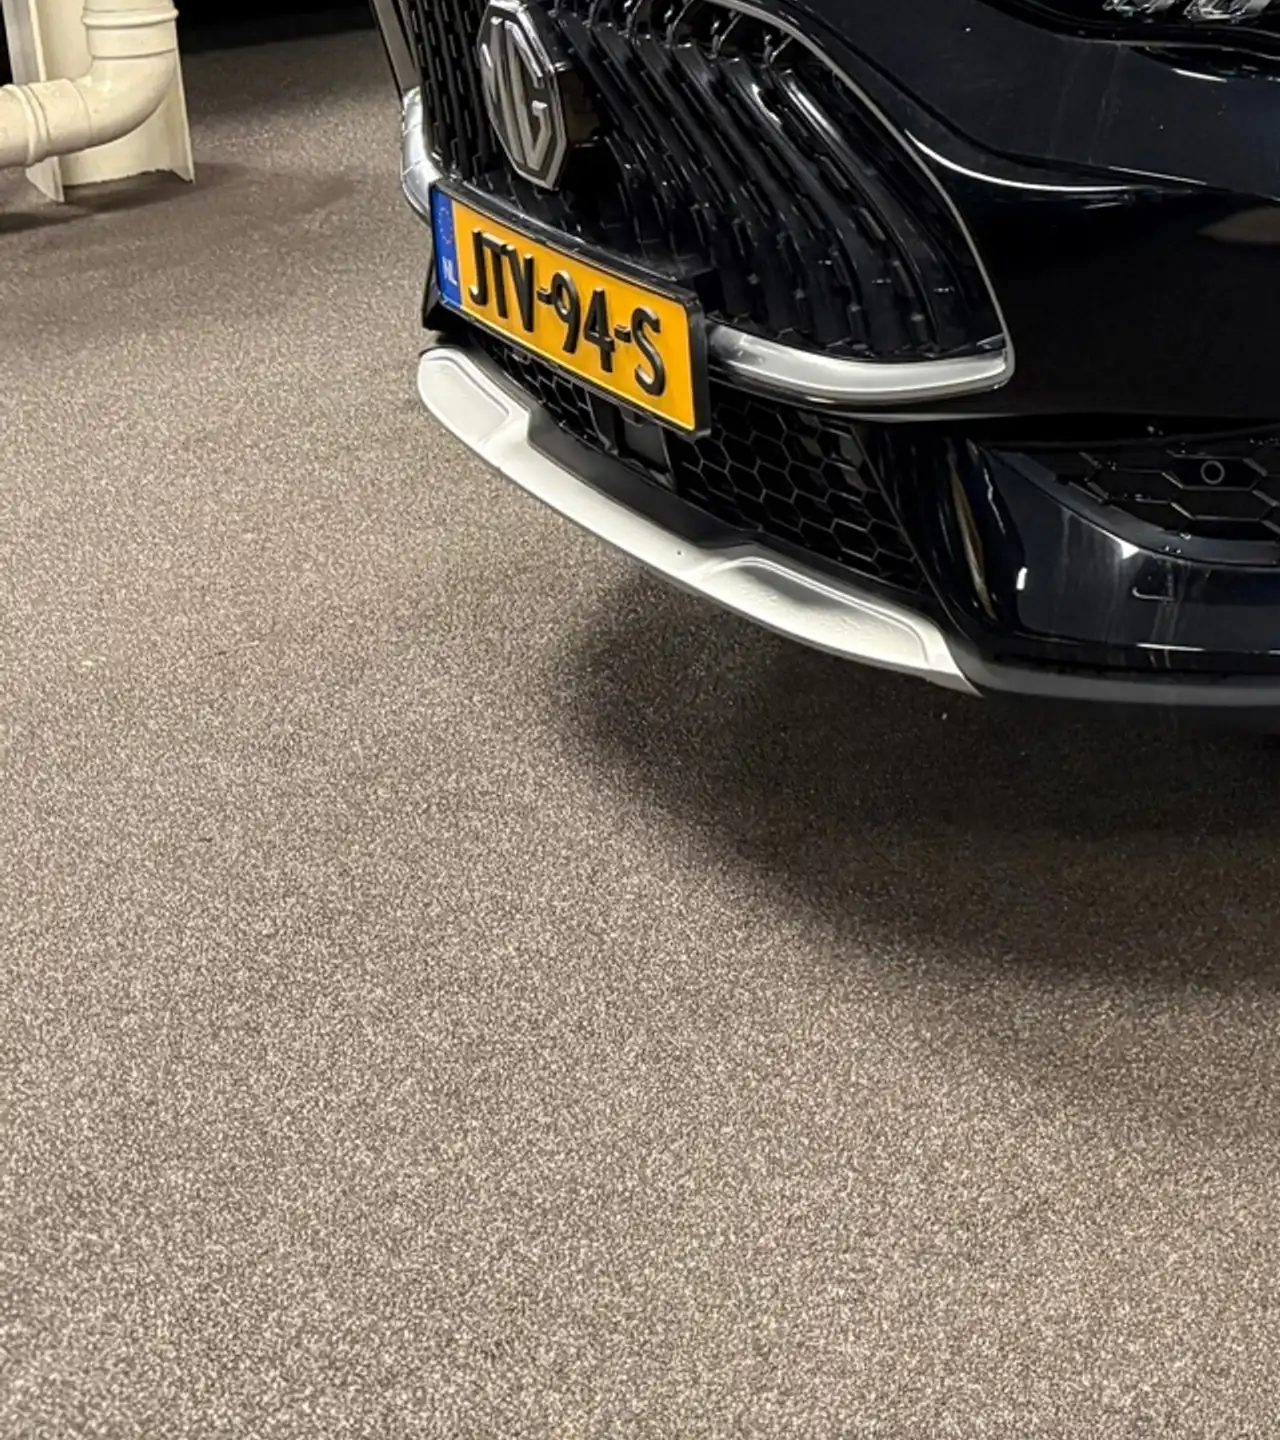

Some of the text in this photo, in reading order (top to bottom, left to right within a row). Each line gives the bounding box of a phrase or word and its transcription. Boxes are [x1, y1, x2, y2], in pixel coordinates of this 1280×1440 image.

[479, 12, 555, 173] MG
[442, 255, 458, 287] NL
[469, 227, 666, 397] JTV-94-S
